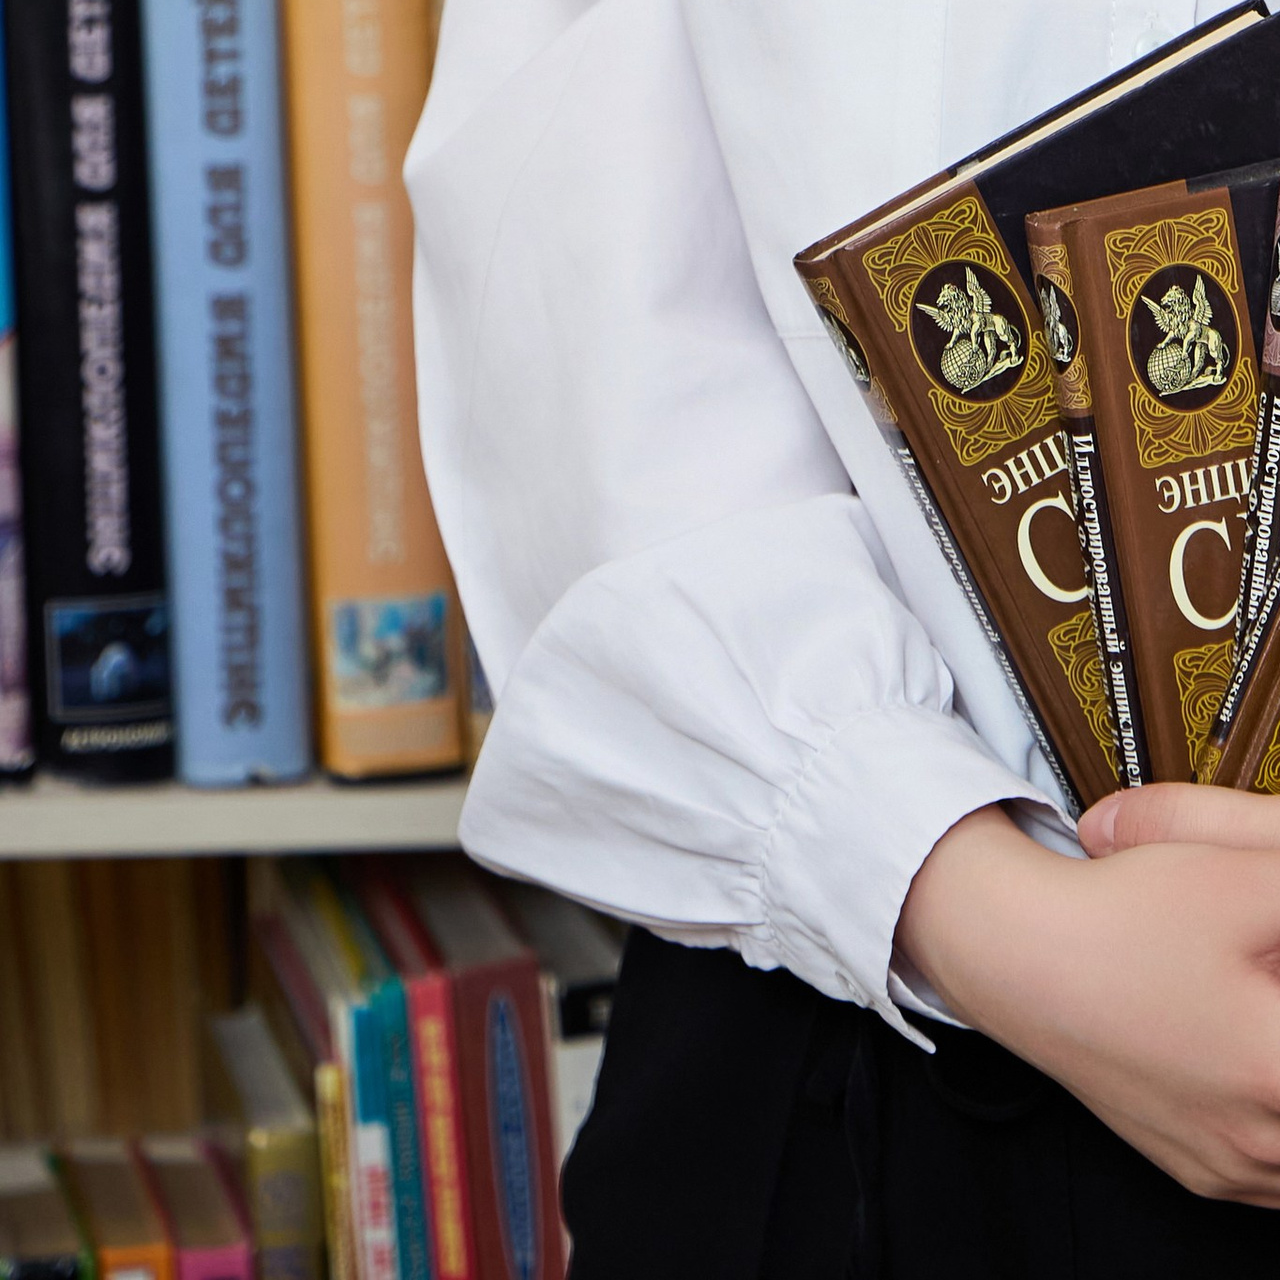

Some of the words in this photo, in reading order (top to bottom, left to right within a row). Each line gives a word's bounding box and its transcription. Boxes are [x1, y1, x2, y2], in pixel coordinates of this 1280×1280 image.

[70, 95, 117, 191] ДЛЯ
[200, 161, 248, 271] ДЛЯ
[75, 201, 133, 577] ЭНЦИКЛОПЕДИЯ
[206, 293, 264, 731] ЭНЦИКЛОПЕДИЯ
[896, 446, 1001, 647] Иллюстрированный
[1071, 432, 1127, 655] Иллюстрированный
